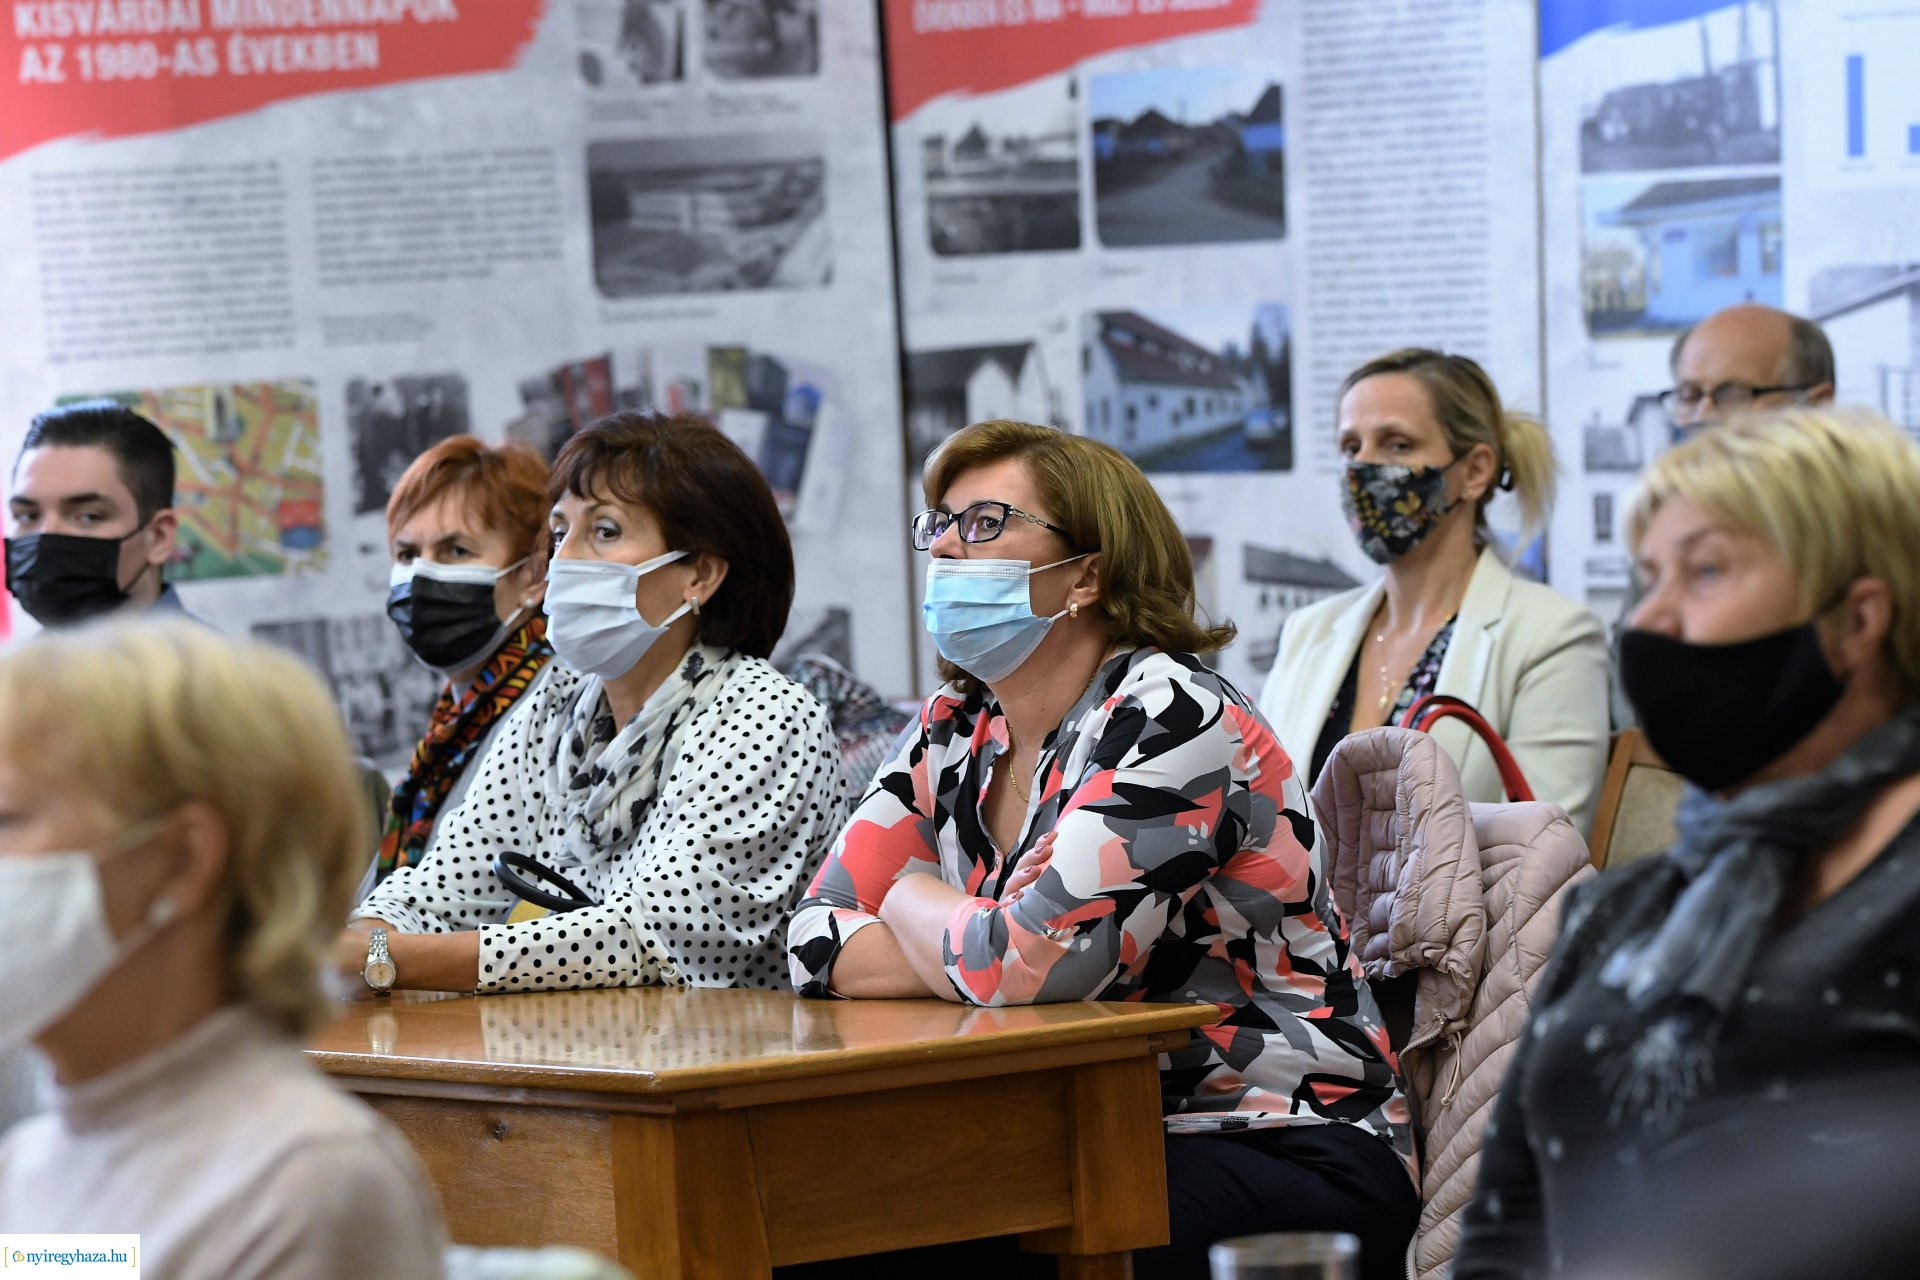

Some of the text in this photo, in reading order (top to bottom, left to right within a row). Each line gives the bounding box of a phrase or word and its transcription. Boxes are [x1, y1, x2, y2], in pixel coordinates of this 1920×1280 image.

[19, 28, 380, 84] AZ 1980-AS ÉVEKBEN
